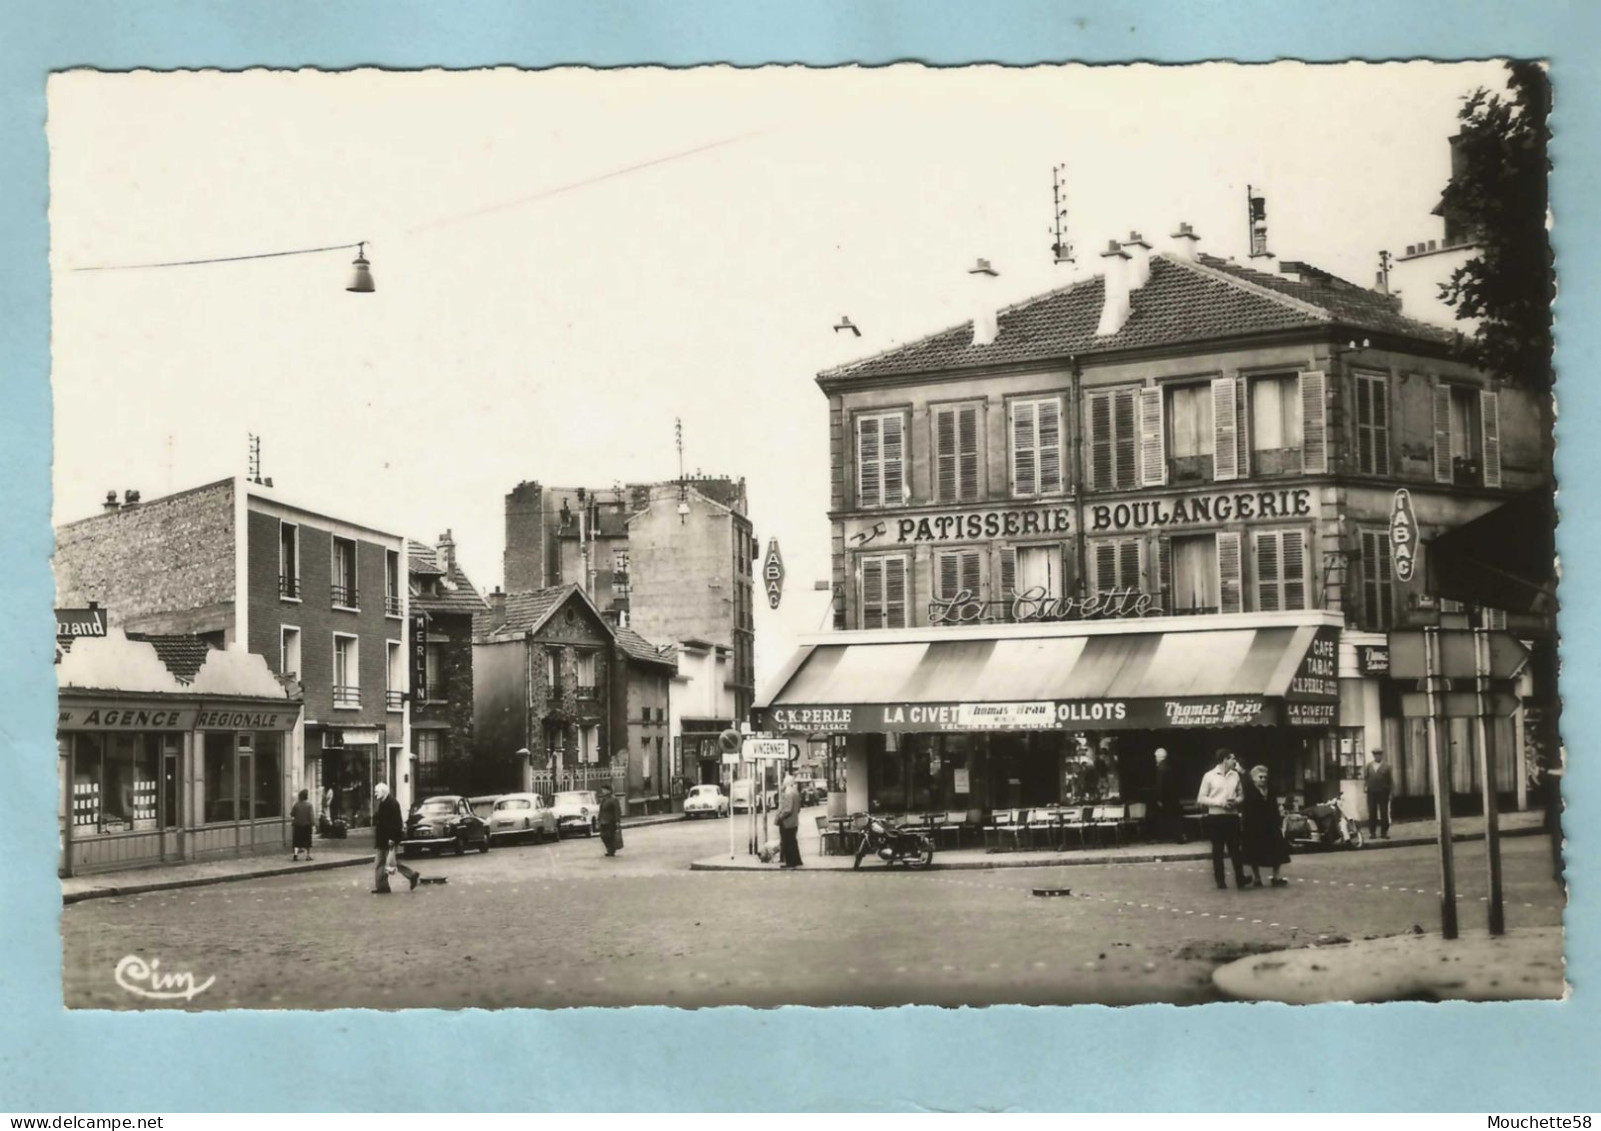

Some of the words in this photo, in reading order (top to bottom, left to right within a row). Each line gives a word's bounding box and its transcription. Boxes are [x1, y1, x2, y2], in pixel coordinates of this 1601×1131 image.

[896, 508, 1070, 543] PATISSERIE
[1091, 489, 1311, 530] BOULANGERIE
[1393, 494, 1410, 575] TABAC
[767, 538, 780, 607] TABAC
[927, 588, 996, 623] La
[1010, 586, 1164, 622] Civette
[416, 616, 425, 700] MERLIN
[1307, 657, 1333, 676] TABAC
[83, 710, 181, 726] AGENCE
[883, 707, 902, 723] LA
[1288, 704, 1300, 715] LA
[1301, 705, 1335, 716] CIVETTE
